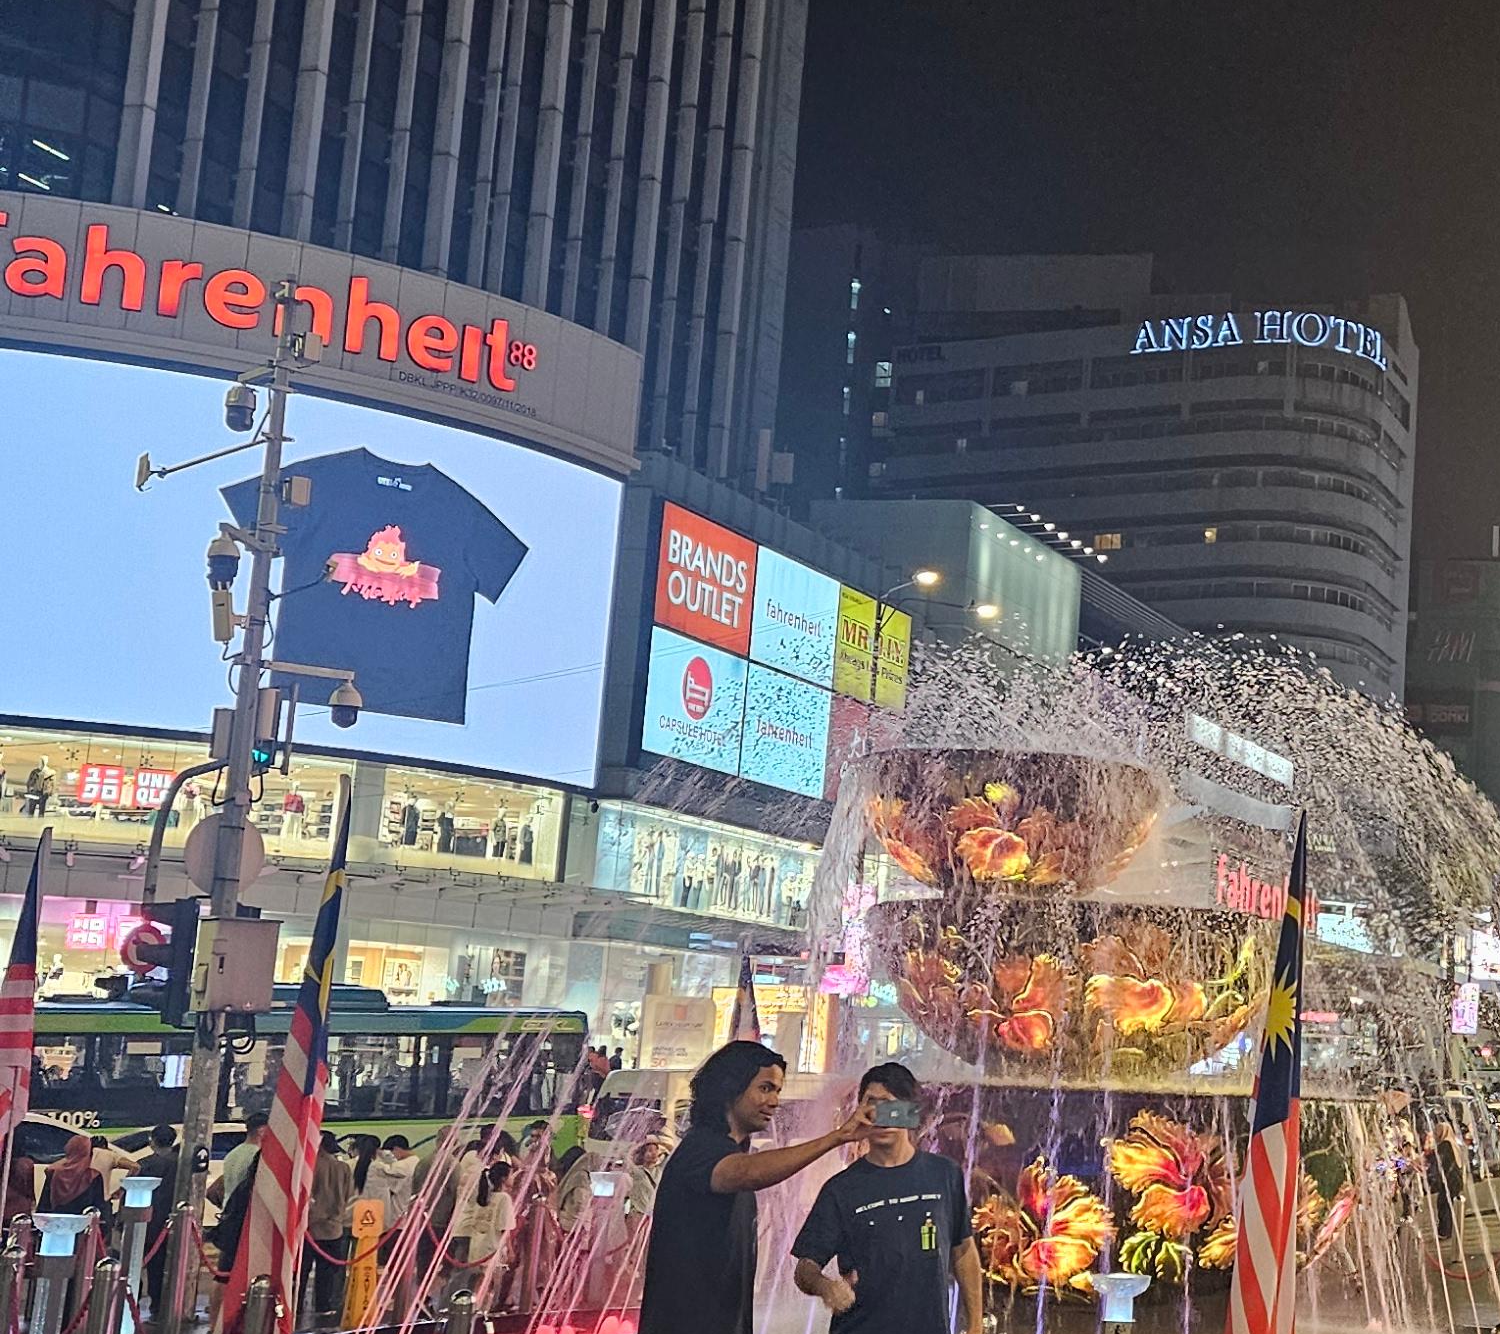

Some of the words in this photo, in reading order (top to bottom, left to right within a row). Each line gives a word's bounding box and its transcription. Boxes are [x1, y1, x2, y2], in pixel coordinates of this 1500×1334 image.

[0, 211, 517, 392] ahrenheit
[510, 340, 537, 371] 88
[1130, 311, 1243, 354] ANSA
[1253, 310, 1388, 371] HOTEL
[668, 529, 748, 595] BRANDS
[667, 570, 744, 629] OUTLET
[766, 598, 822, 638] fahrenheit
